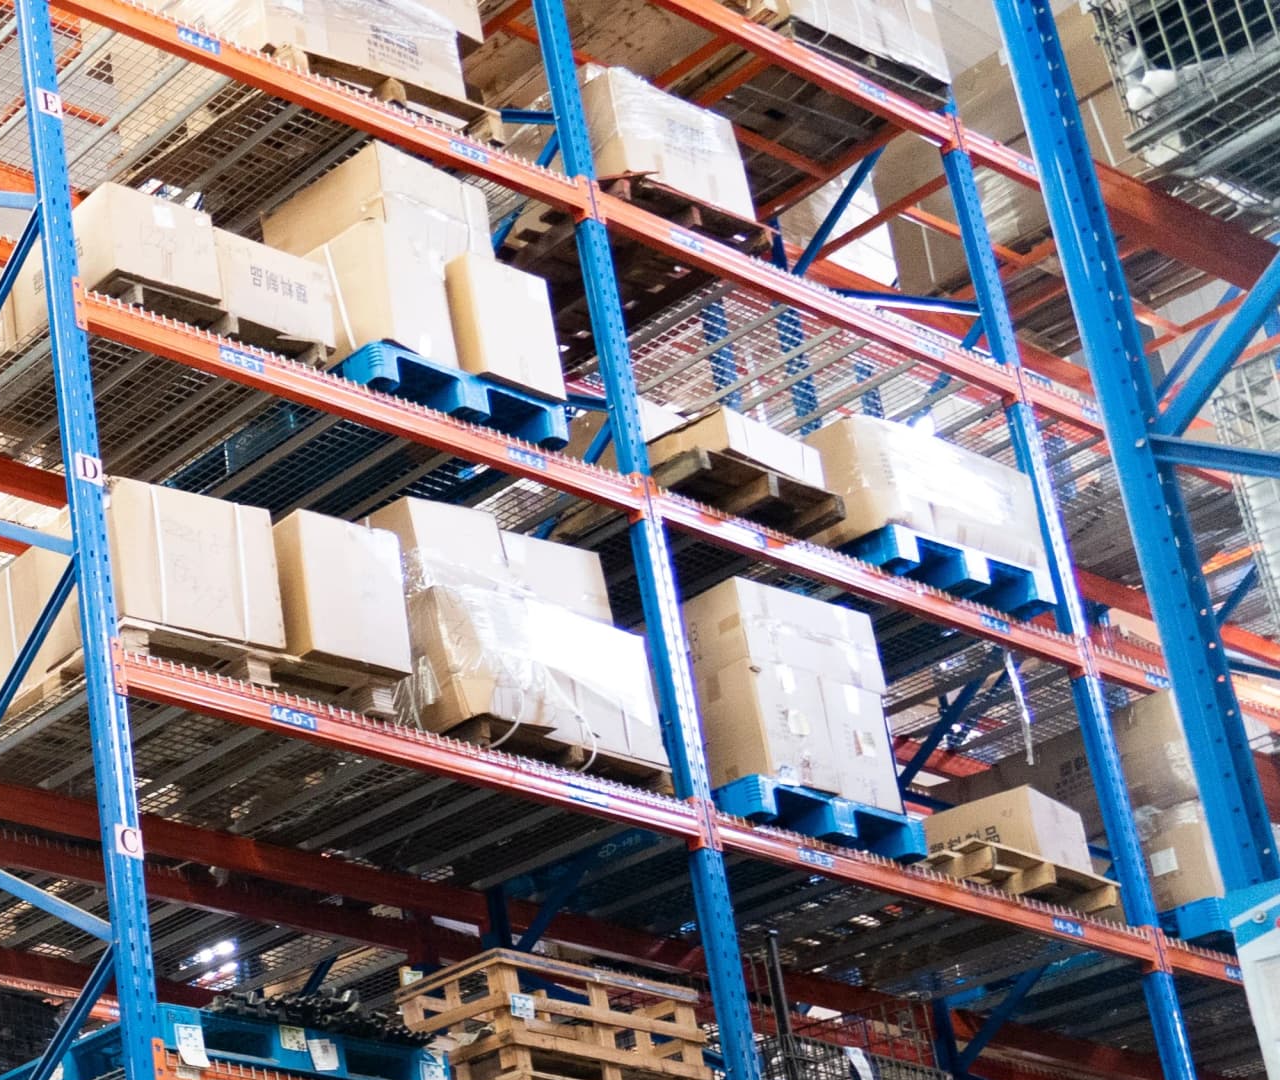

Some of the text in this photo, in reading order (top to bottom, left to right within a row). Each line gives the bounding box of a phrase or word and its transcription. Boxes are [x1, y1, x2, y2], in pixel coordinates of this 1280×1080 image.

[43, 92, 58, 115] E
[80, 456, 98, 479] D
[120, 828, 138, 854] C
